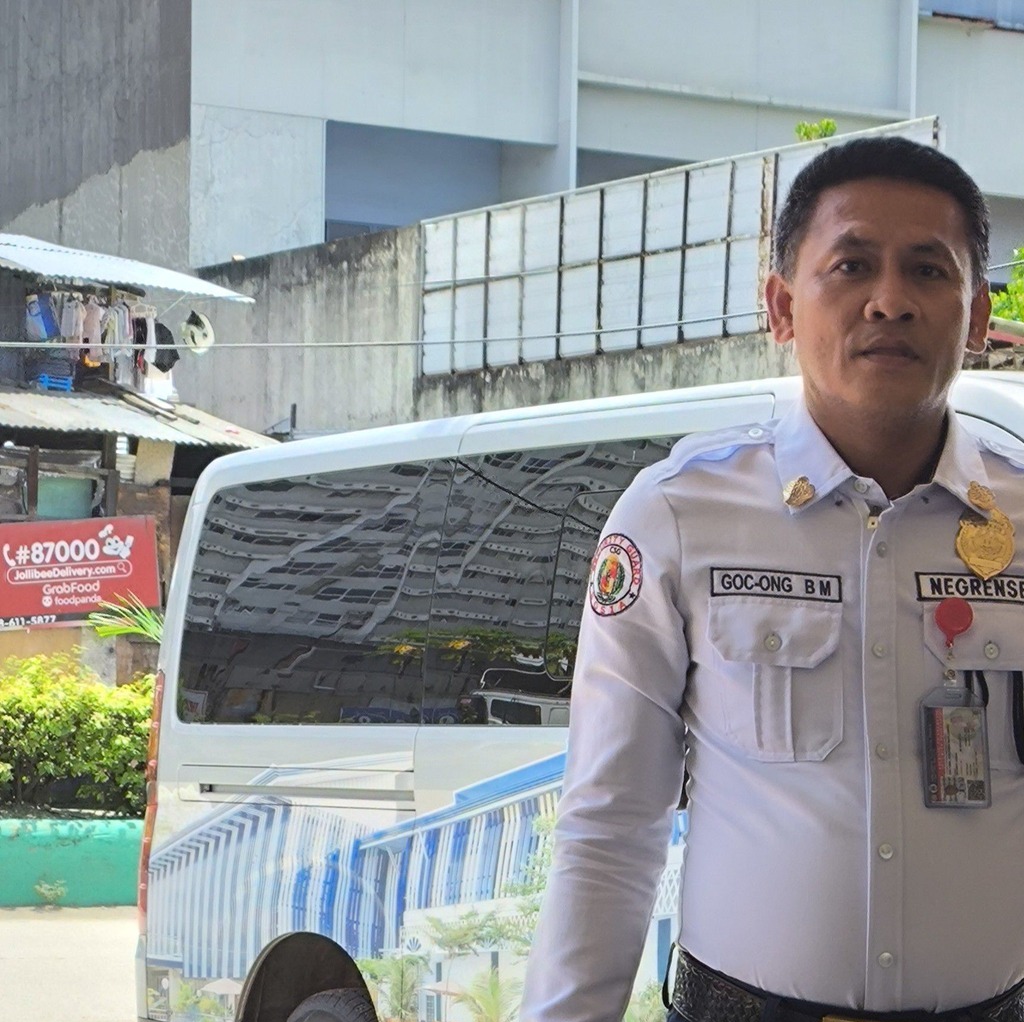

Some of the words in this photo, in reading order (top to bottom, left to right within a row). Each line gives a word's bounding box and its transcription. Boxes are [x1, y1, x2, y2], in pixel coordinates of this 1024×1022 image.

[15, 538, 100, 565] #87000
[14, 564, 116, 581] JollibeeDelivery.com
[42, 580, 100, 595] GrabFood
[721, 573, 793, 593] GOC-ONG
[804, 579, 816, 594] B
[819, 580, 831, 597] M
[54, 594, 102, 607] foodpanda
